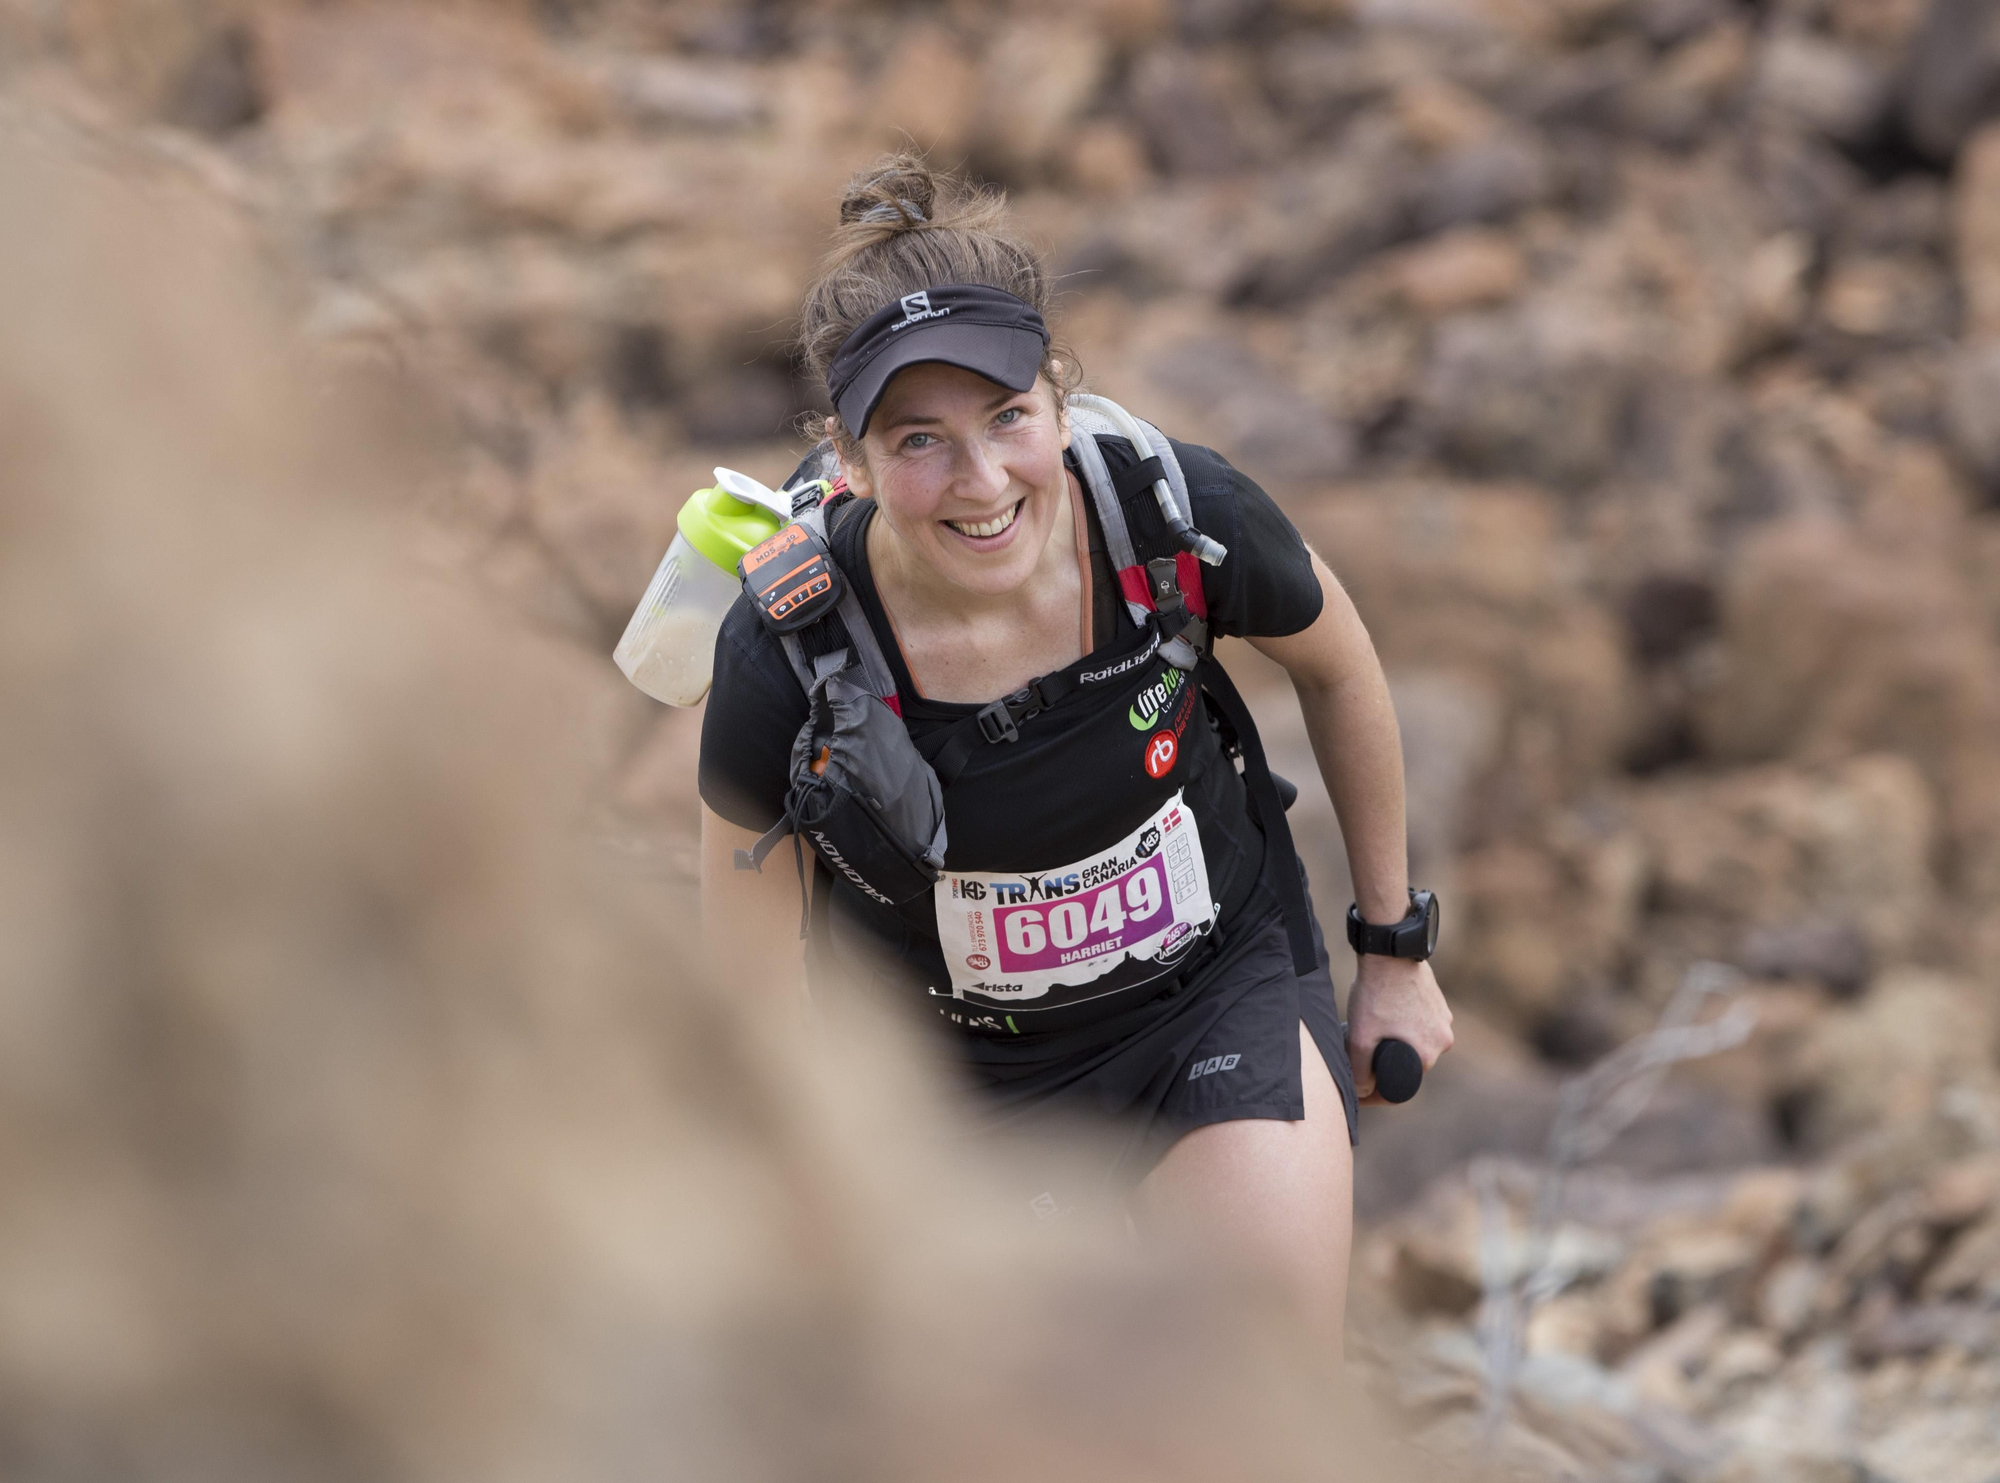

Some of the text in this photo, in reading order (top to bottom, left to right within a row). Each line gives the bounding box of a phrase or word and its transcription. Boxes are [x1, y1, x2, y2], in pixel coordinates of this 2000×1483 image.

[810, 830, 894, 905] SALOMON
[1082, 856, 1118, 879] GRAN
[1083, 856, 1138, 889] CANARIA
[1004, 866, 1163, 955] 6049
[974, 911, 987, 952] 673 970 540
[1060, 936, 1123, 964] HARRIET
[1190, 1055, 1239, 1079] LAB
